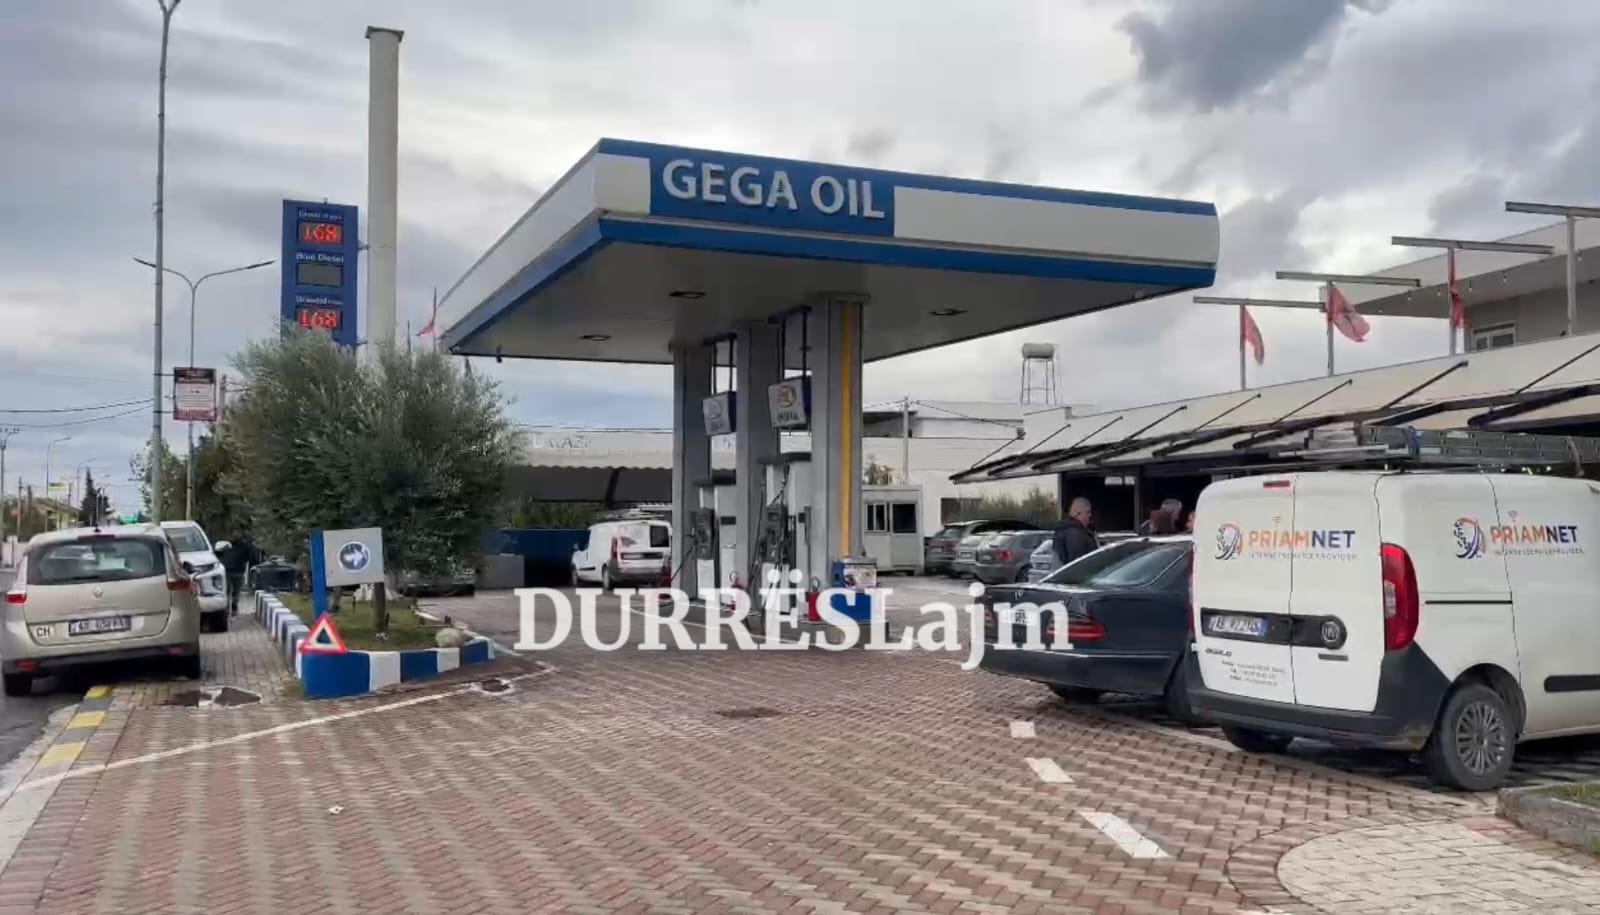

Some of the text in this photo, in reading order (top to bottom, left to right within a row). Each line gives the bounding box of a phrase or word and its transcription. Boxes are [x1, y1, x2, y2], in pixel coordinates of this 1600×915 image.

[662, 158, 886, 219] GEGA OIL
[303, 223, 338, 243] 168
[298, 310, 338, 330] 168
[1250, 528, 1356, 549] PRIAMNET
[1489, 524, 1578, 544] PRIAMNET
[36, 627, 51, 638] CH
